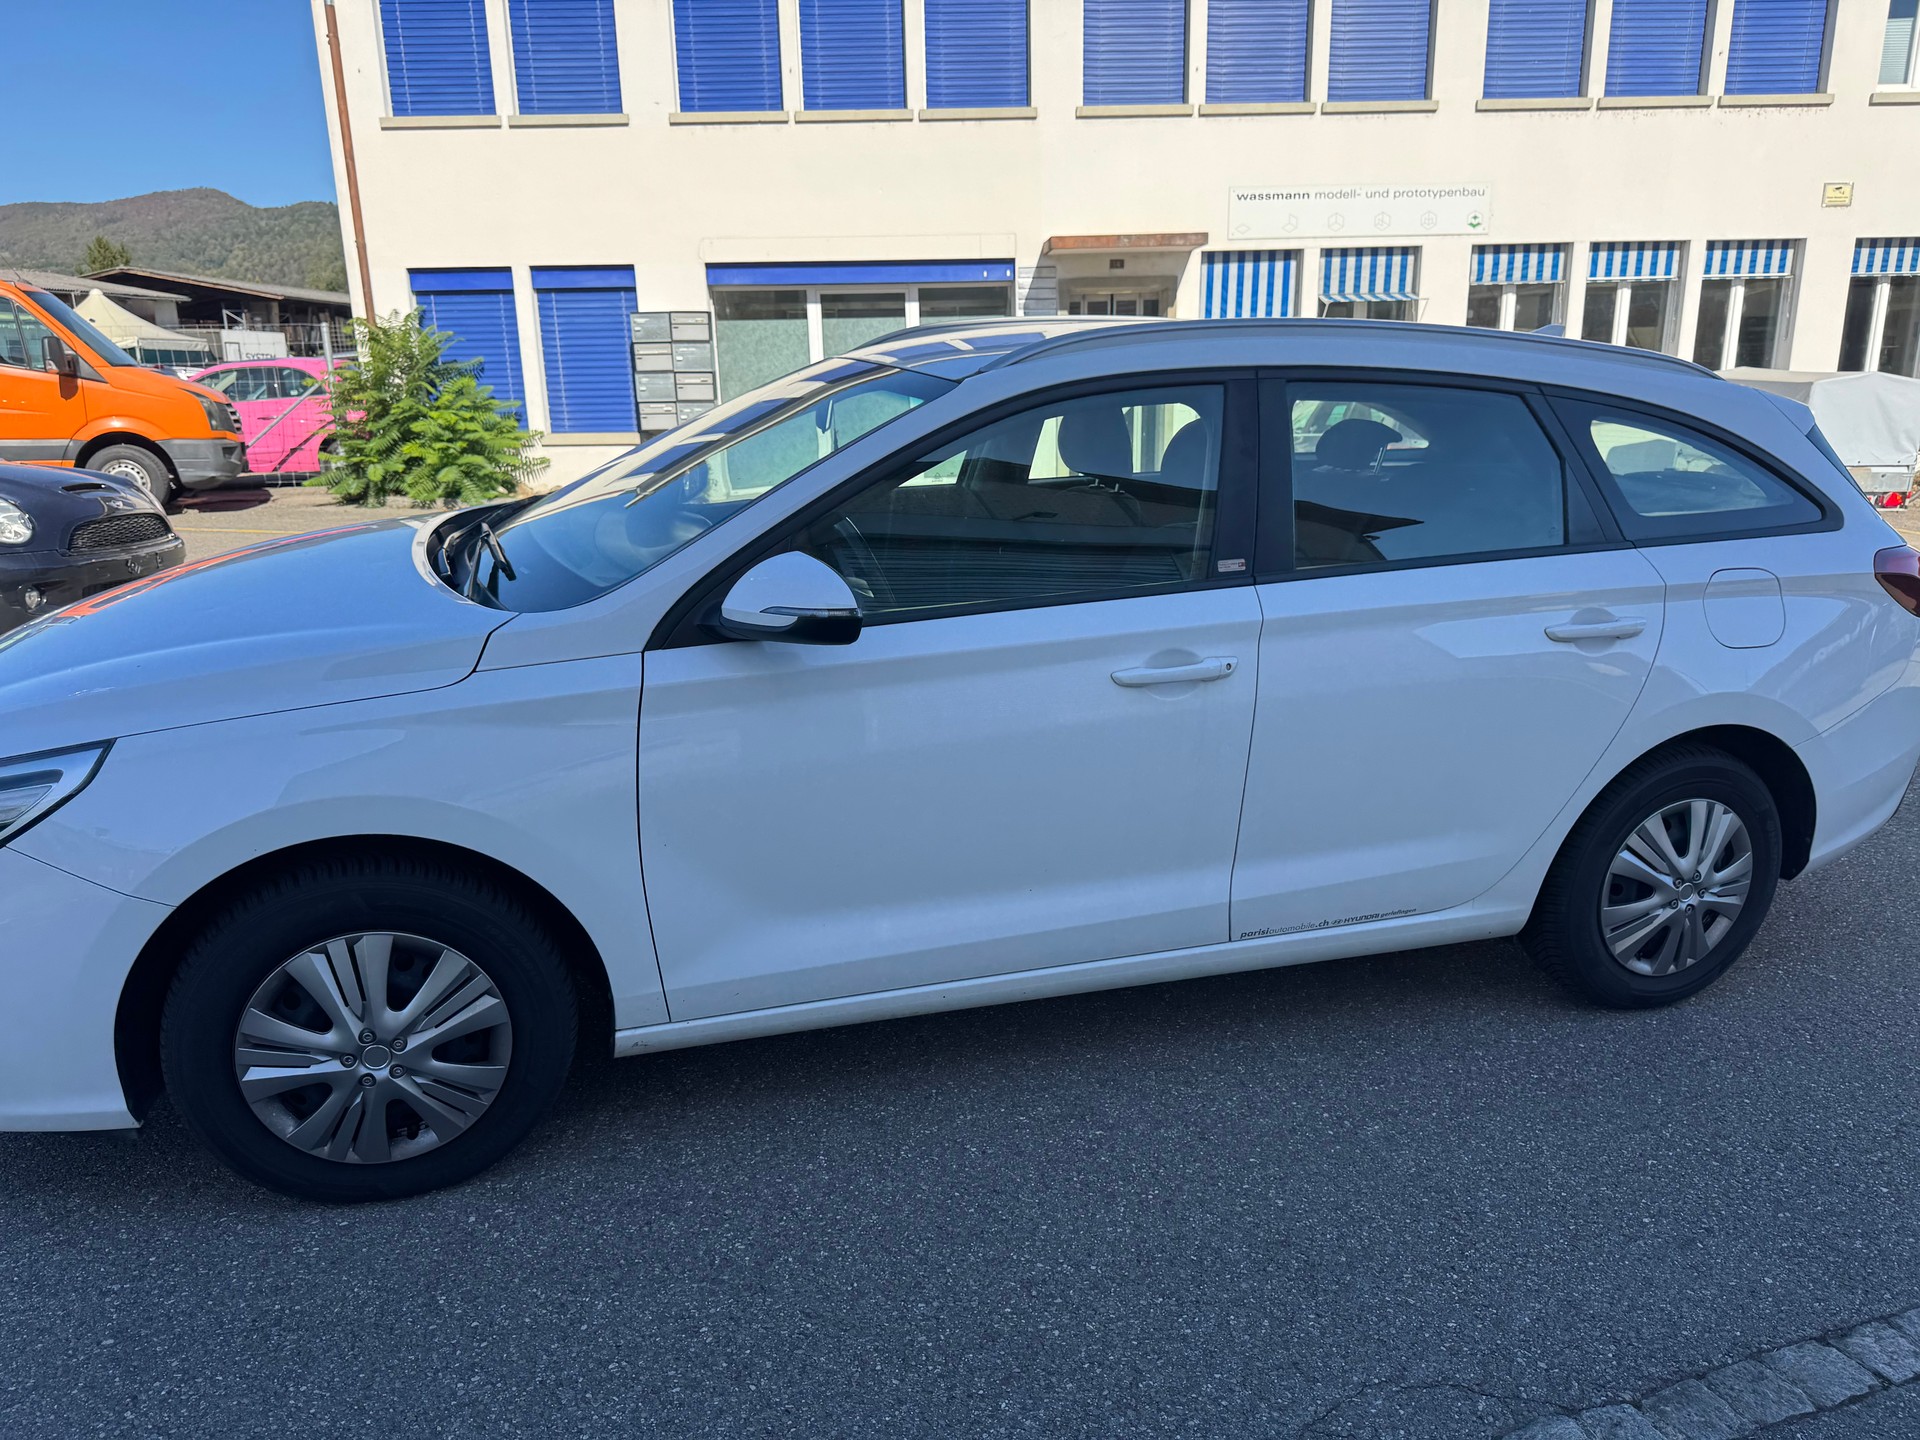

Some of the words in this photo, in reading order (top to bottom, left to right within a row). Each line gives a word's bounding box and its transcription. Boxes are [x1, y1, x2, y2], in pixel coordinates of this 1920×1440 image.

[1237, 191, 1310, 201] wassmann
[1314, 189, 1361, 200] modell-
[1365, 188, 1389, 199] und
[1393, 187, 1485, 201] prototypenbau
[1343, 913, 1380, 924] HYUNDAI
